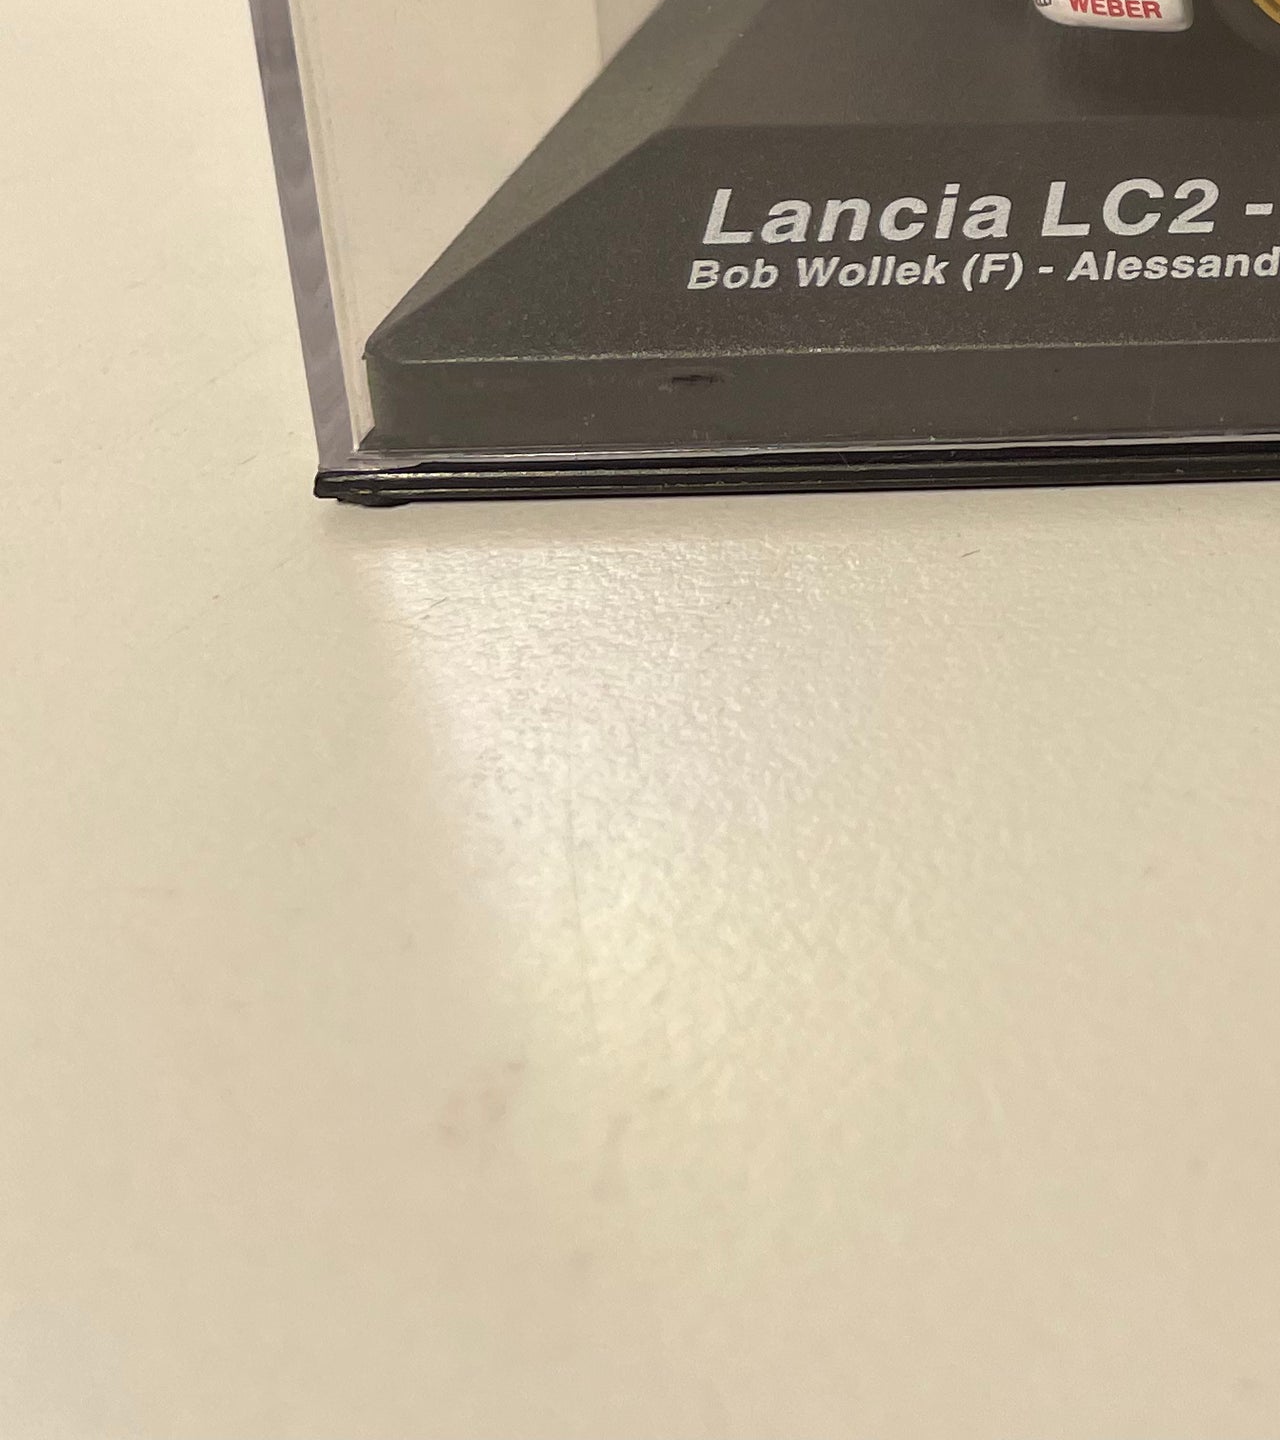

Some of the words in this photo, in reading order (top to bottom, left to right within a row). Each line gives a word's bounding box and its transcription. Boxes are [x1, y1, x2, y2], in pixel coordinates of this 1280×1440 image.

[702, 183, 1012, 245] Lancia
[1040, 177, 1220, 237] LC2
[1244, 202, 1274, 216] -
[687, 258, 779, 290] Bob
[797, 253, 951, 288] Wollek
[961, 251, 1025, 292] (F)
[1038, 264, 1054, 275] -
